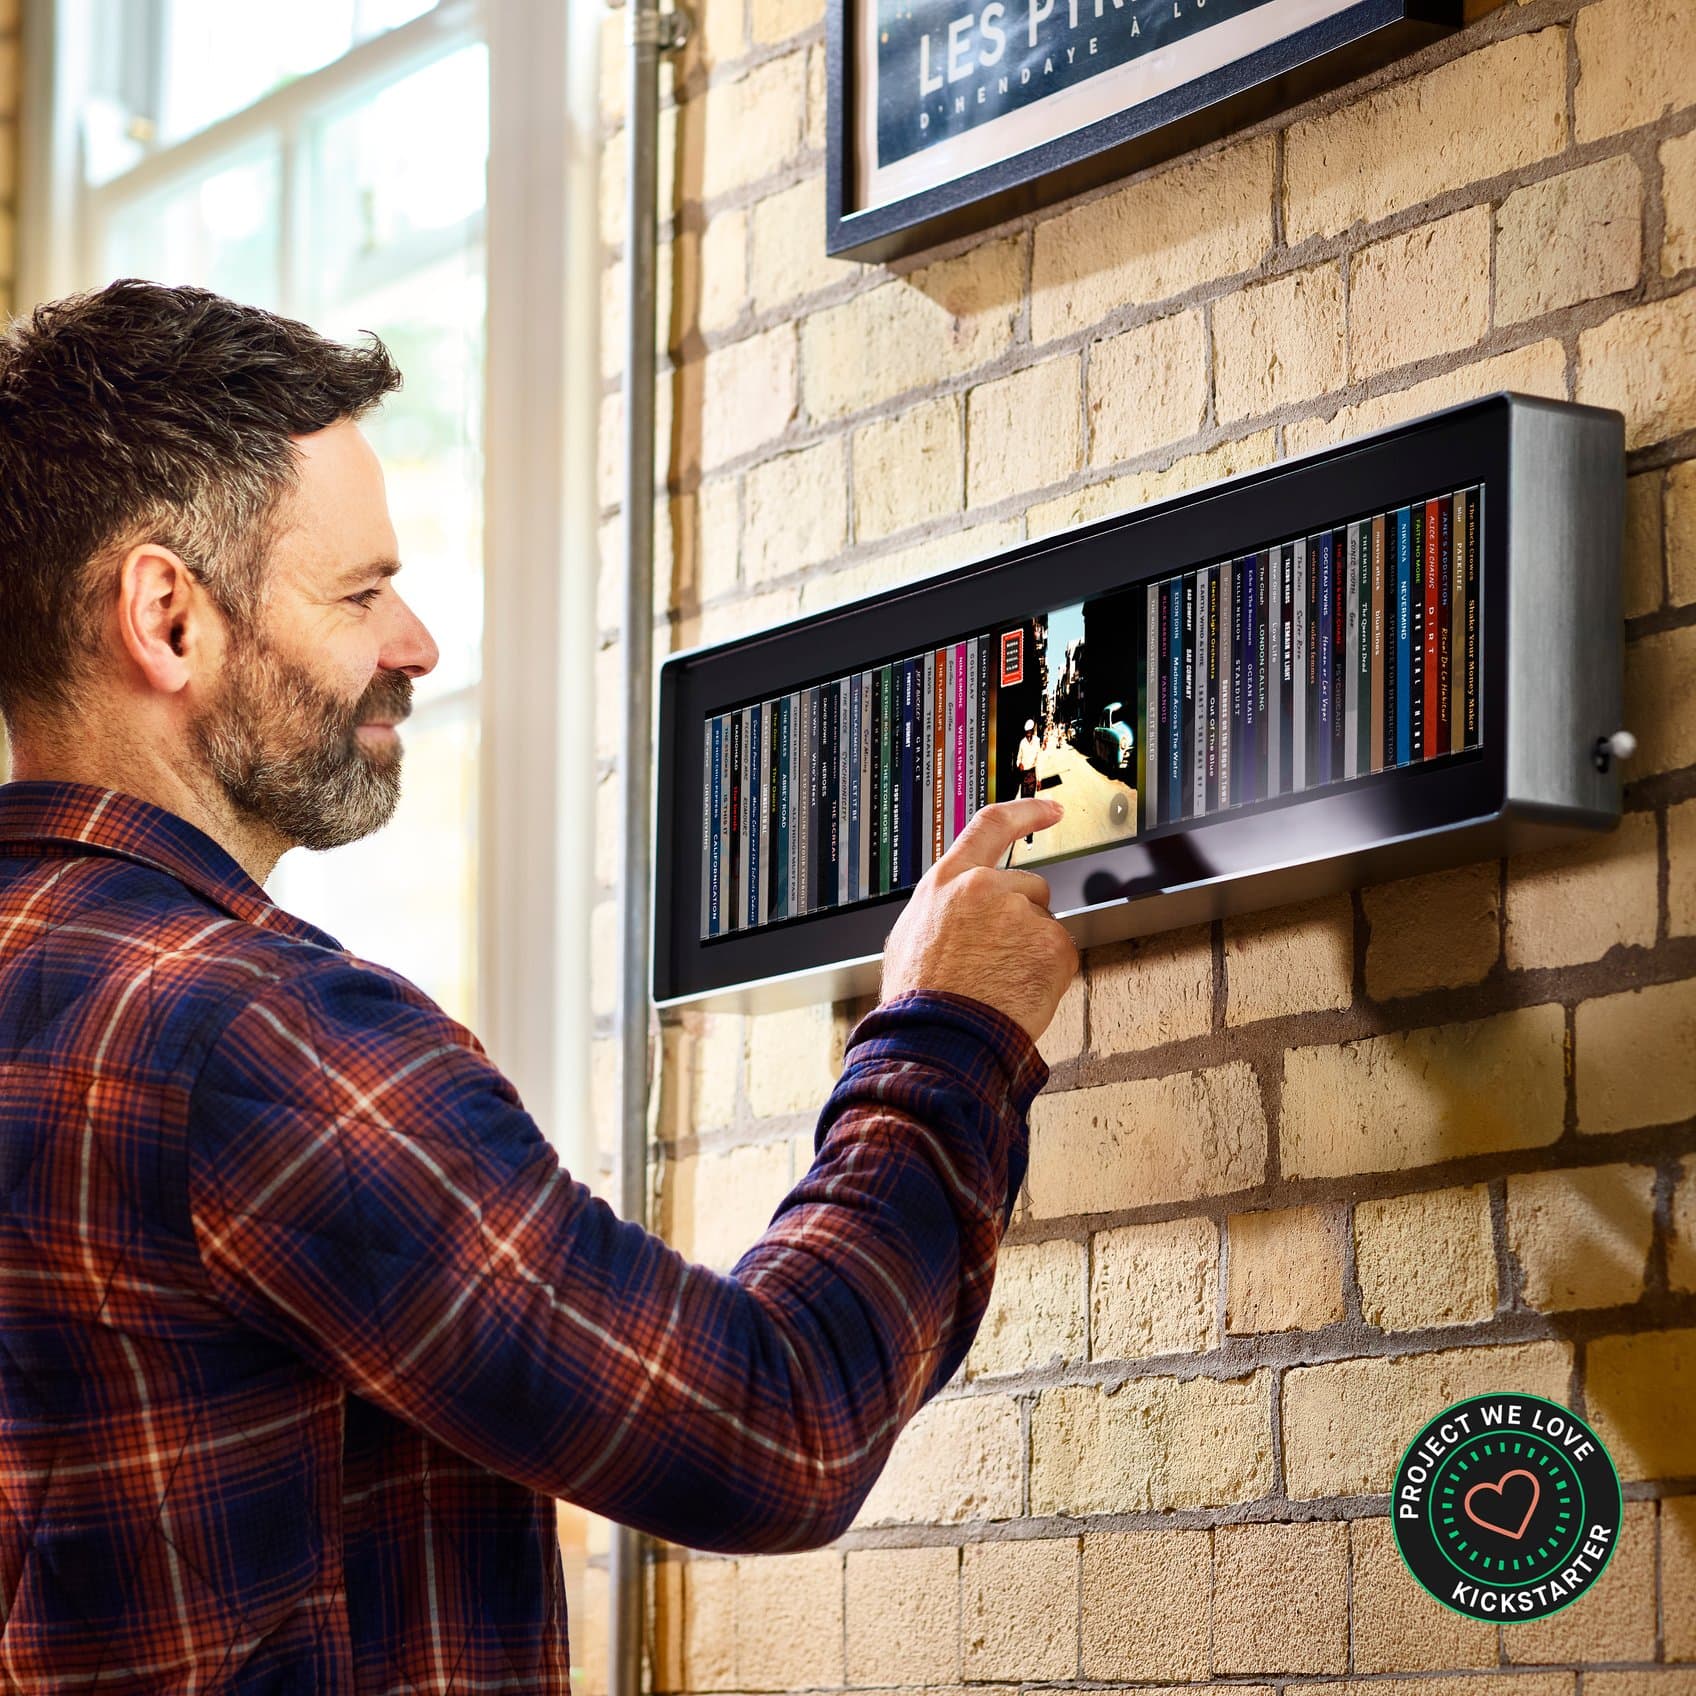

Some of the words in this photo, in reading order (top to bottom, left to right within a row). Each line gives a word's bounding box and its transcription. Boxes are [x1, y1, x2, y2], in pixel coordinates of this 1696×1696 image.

[1131, 15, 1141, 37] À
[920, 2, 1006, 97] LES
[1210, 719, 1215, 731] Of
